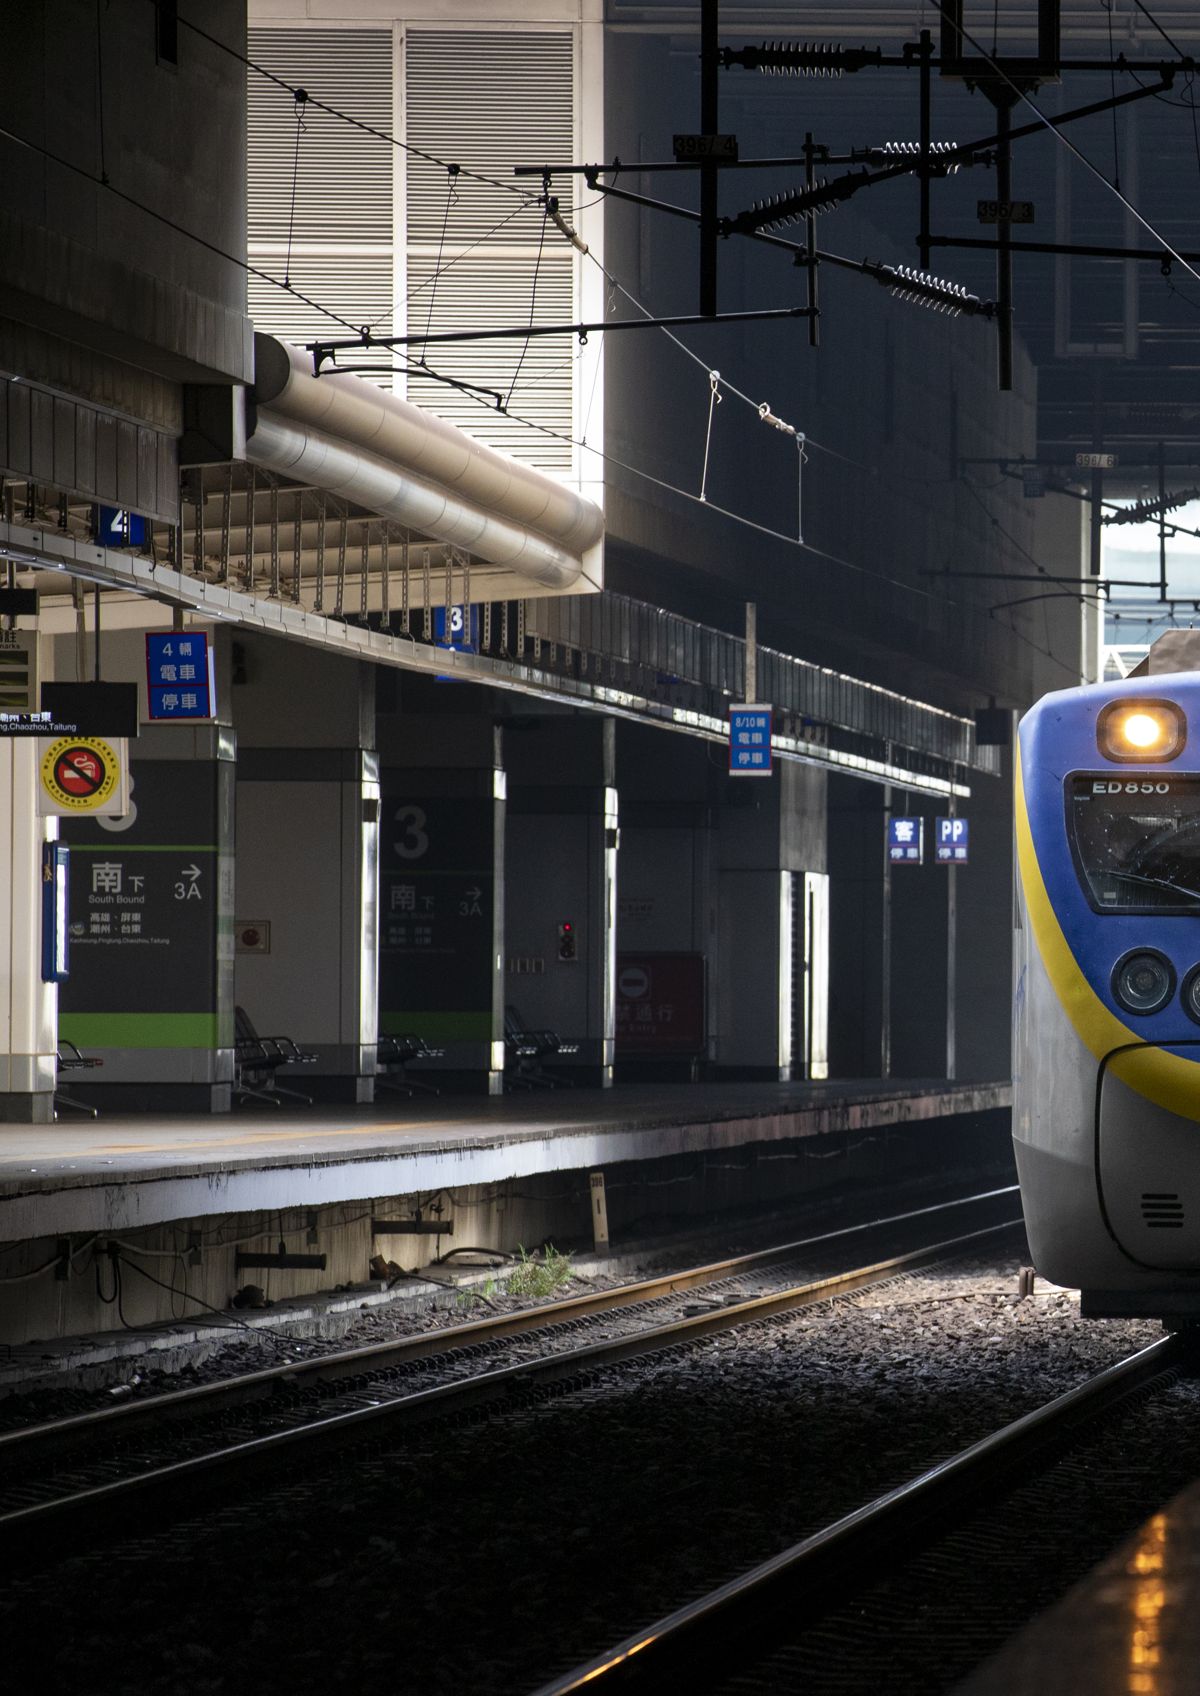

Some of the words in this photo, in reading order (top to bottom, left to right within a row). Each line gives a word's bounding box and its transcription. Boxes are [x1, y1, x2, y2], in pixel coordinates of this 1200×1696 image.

[449, 606, 463, 631] 3
[160, 664, 196, 681] 電車
[162, 693, 198, 710] 停車
[1092, 781, 1170, 794] ED850
[393, 805, 429, 860] 3
[895, 821, 914, 842] 客
[942, 820, 963, 842] PP
[88, 894, 115, 904] South
[116, 894, 145, 904] Bound
[174, 882, 202, 900] 3A
